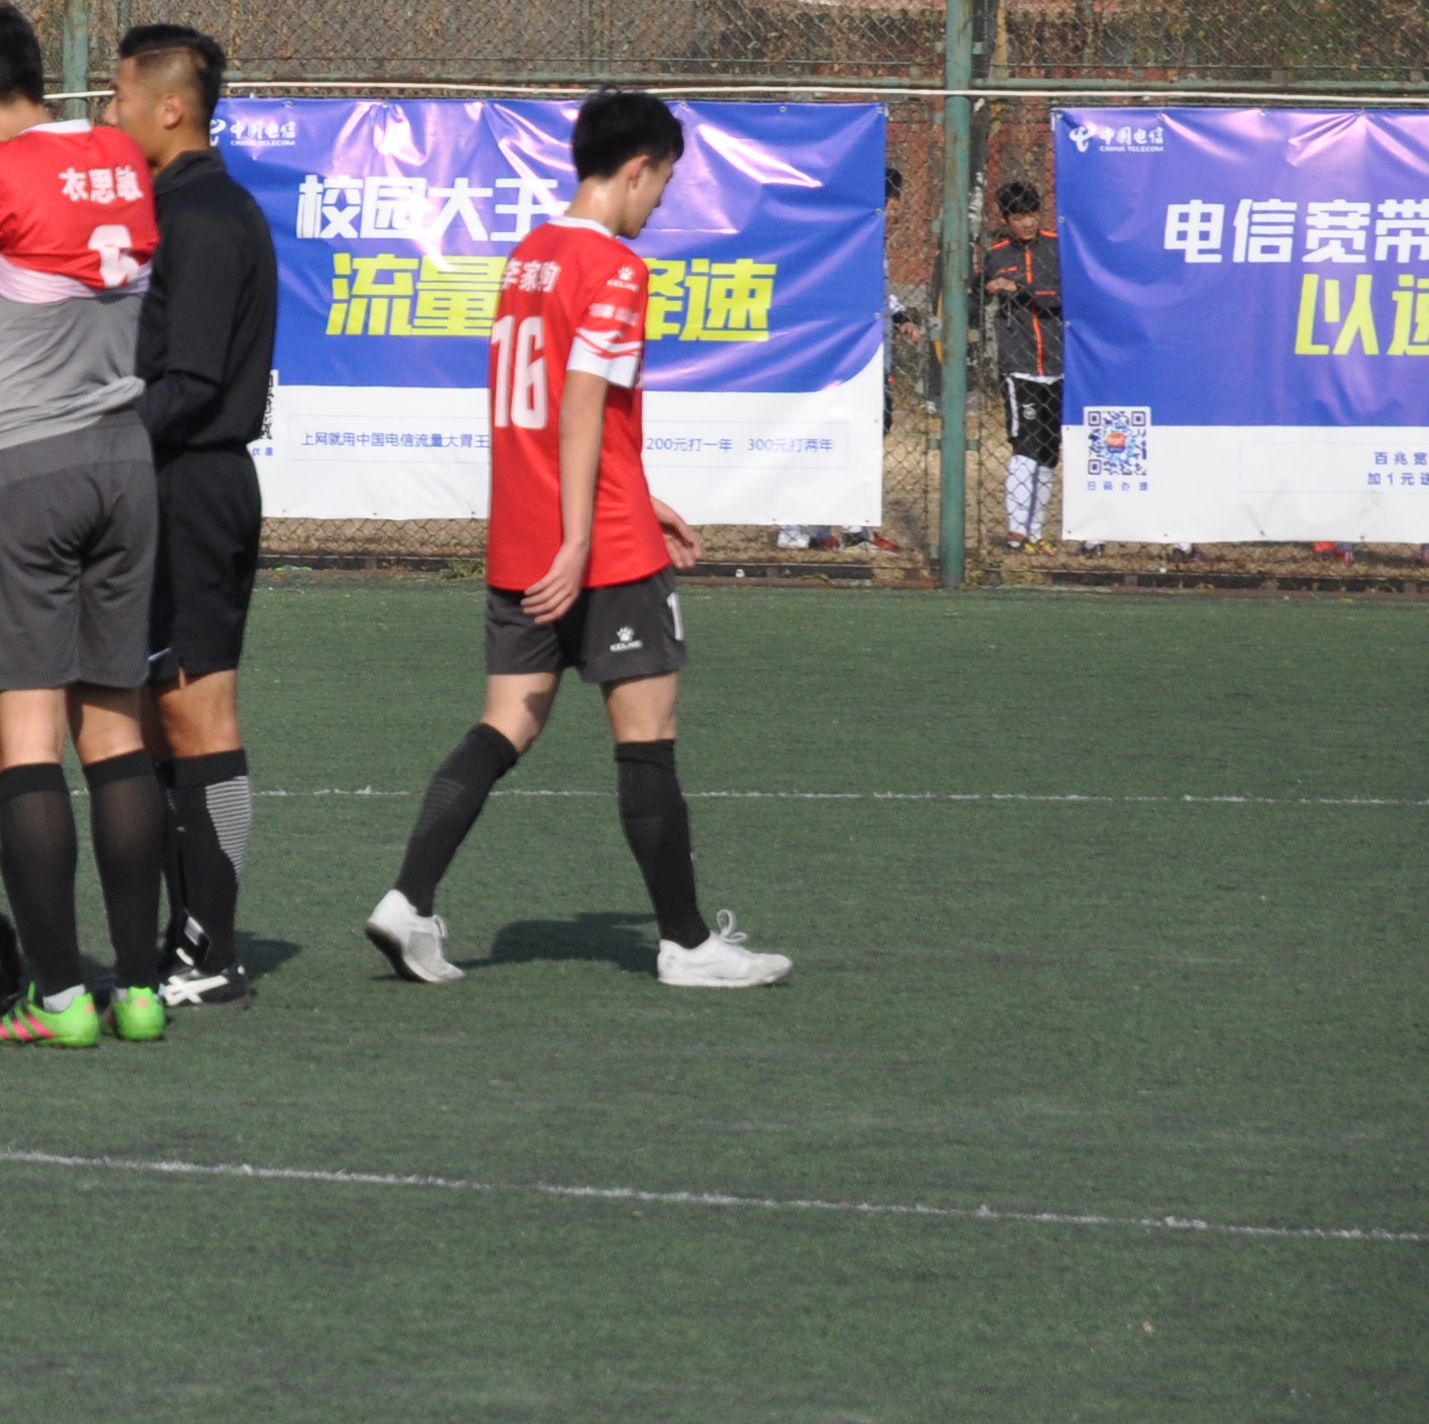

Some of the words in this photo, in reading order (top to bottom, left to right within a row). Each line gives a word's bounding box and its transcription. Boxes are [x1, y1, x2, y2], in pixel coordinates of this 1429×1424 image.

[230, 120, 296, 139] 中国电信
[1099, 126, 1164, 145] 中国电信
[258, 139, 296, 147] TELECOM
[1163, 198, 1429, 264] 电信宽带
[489, 314, 548, 430] 16
[645, 437, 733, 452] 200元打一年
[747, 438, 834, 453] 300元打两年
[609, 639, 643, 653] KELME
